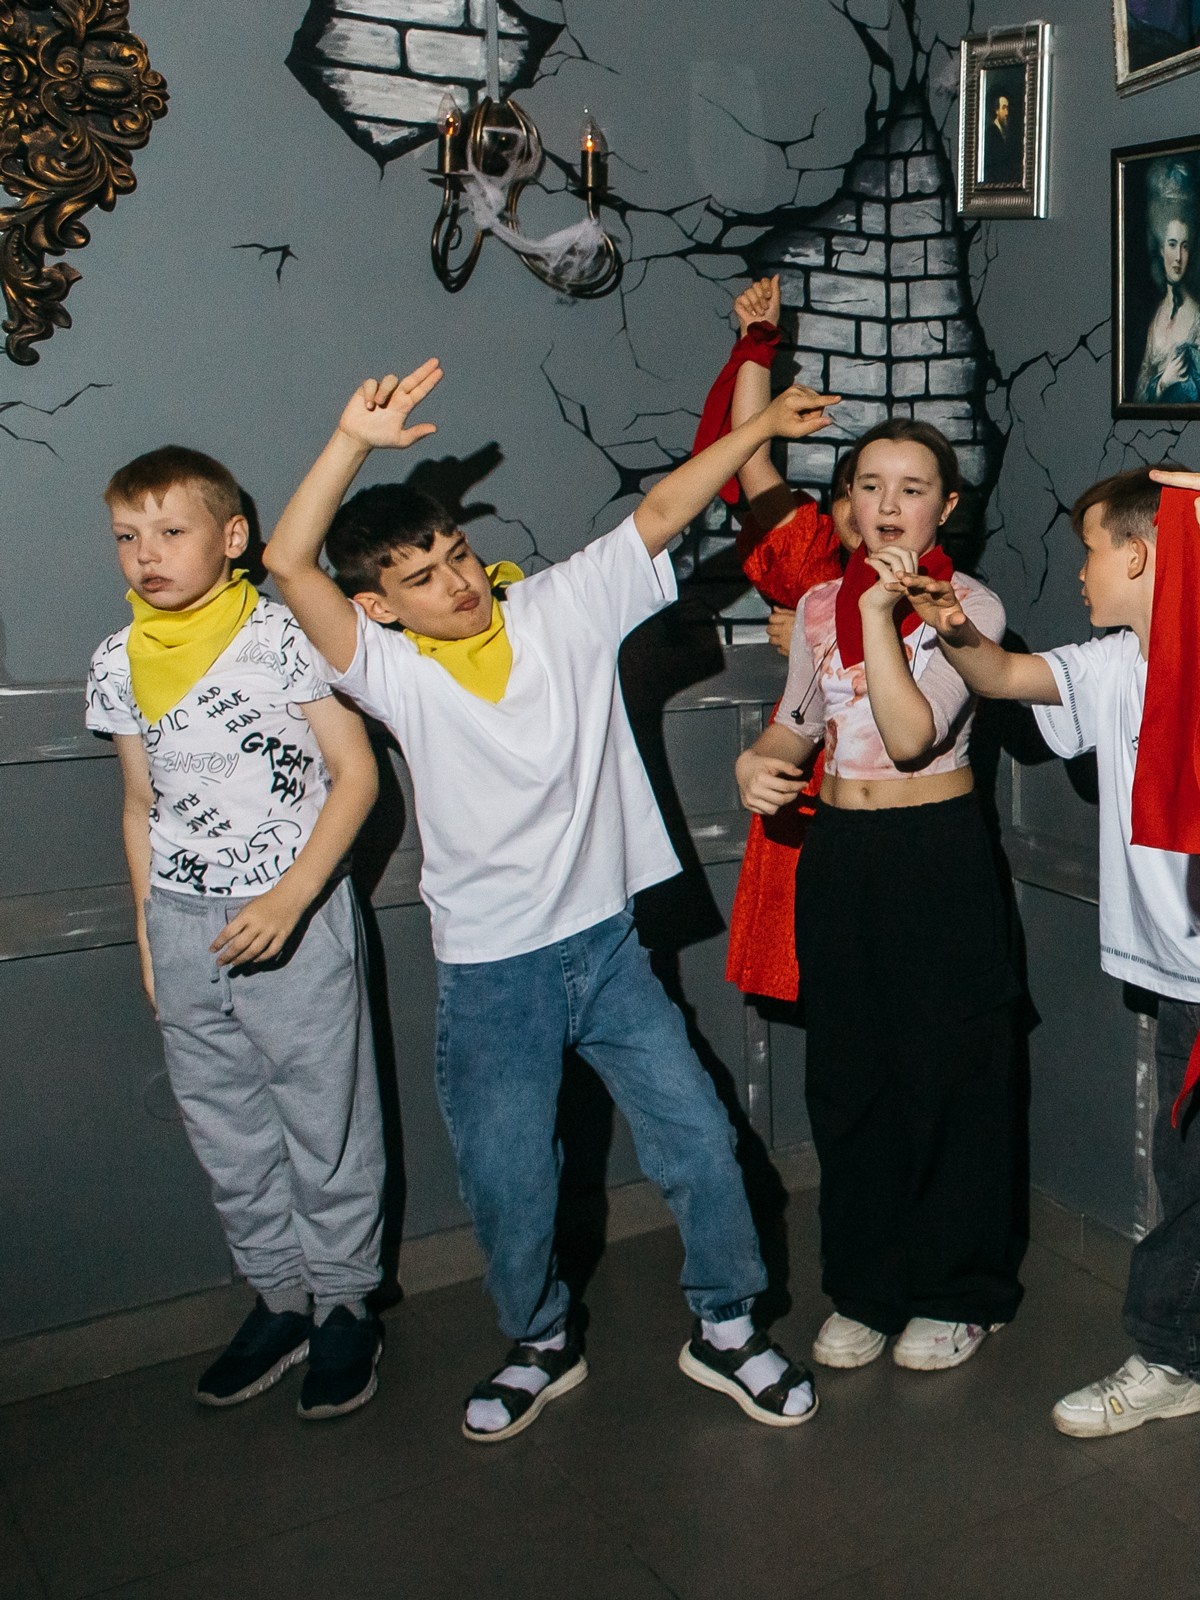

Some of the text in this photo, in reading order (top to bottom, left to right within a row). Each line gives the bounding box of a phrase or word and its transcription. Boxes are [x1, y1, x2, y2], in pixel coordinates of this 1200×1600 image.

[197, 686, 221, 706] AND
[206, 689, 250, 718] HAVE
[225, 709, 262, 733] FUN
[163, 751, 240, 779] ENJOY
[240, 732, 314, 775] GREAT
[271, 771, 306, 807] DAY
[217, 825, 283, 868] JUST
